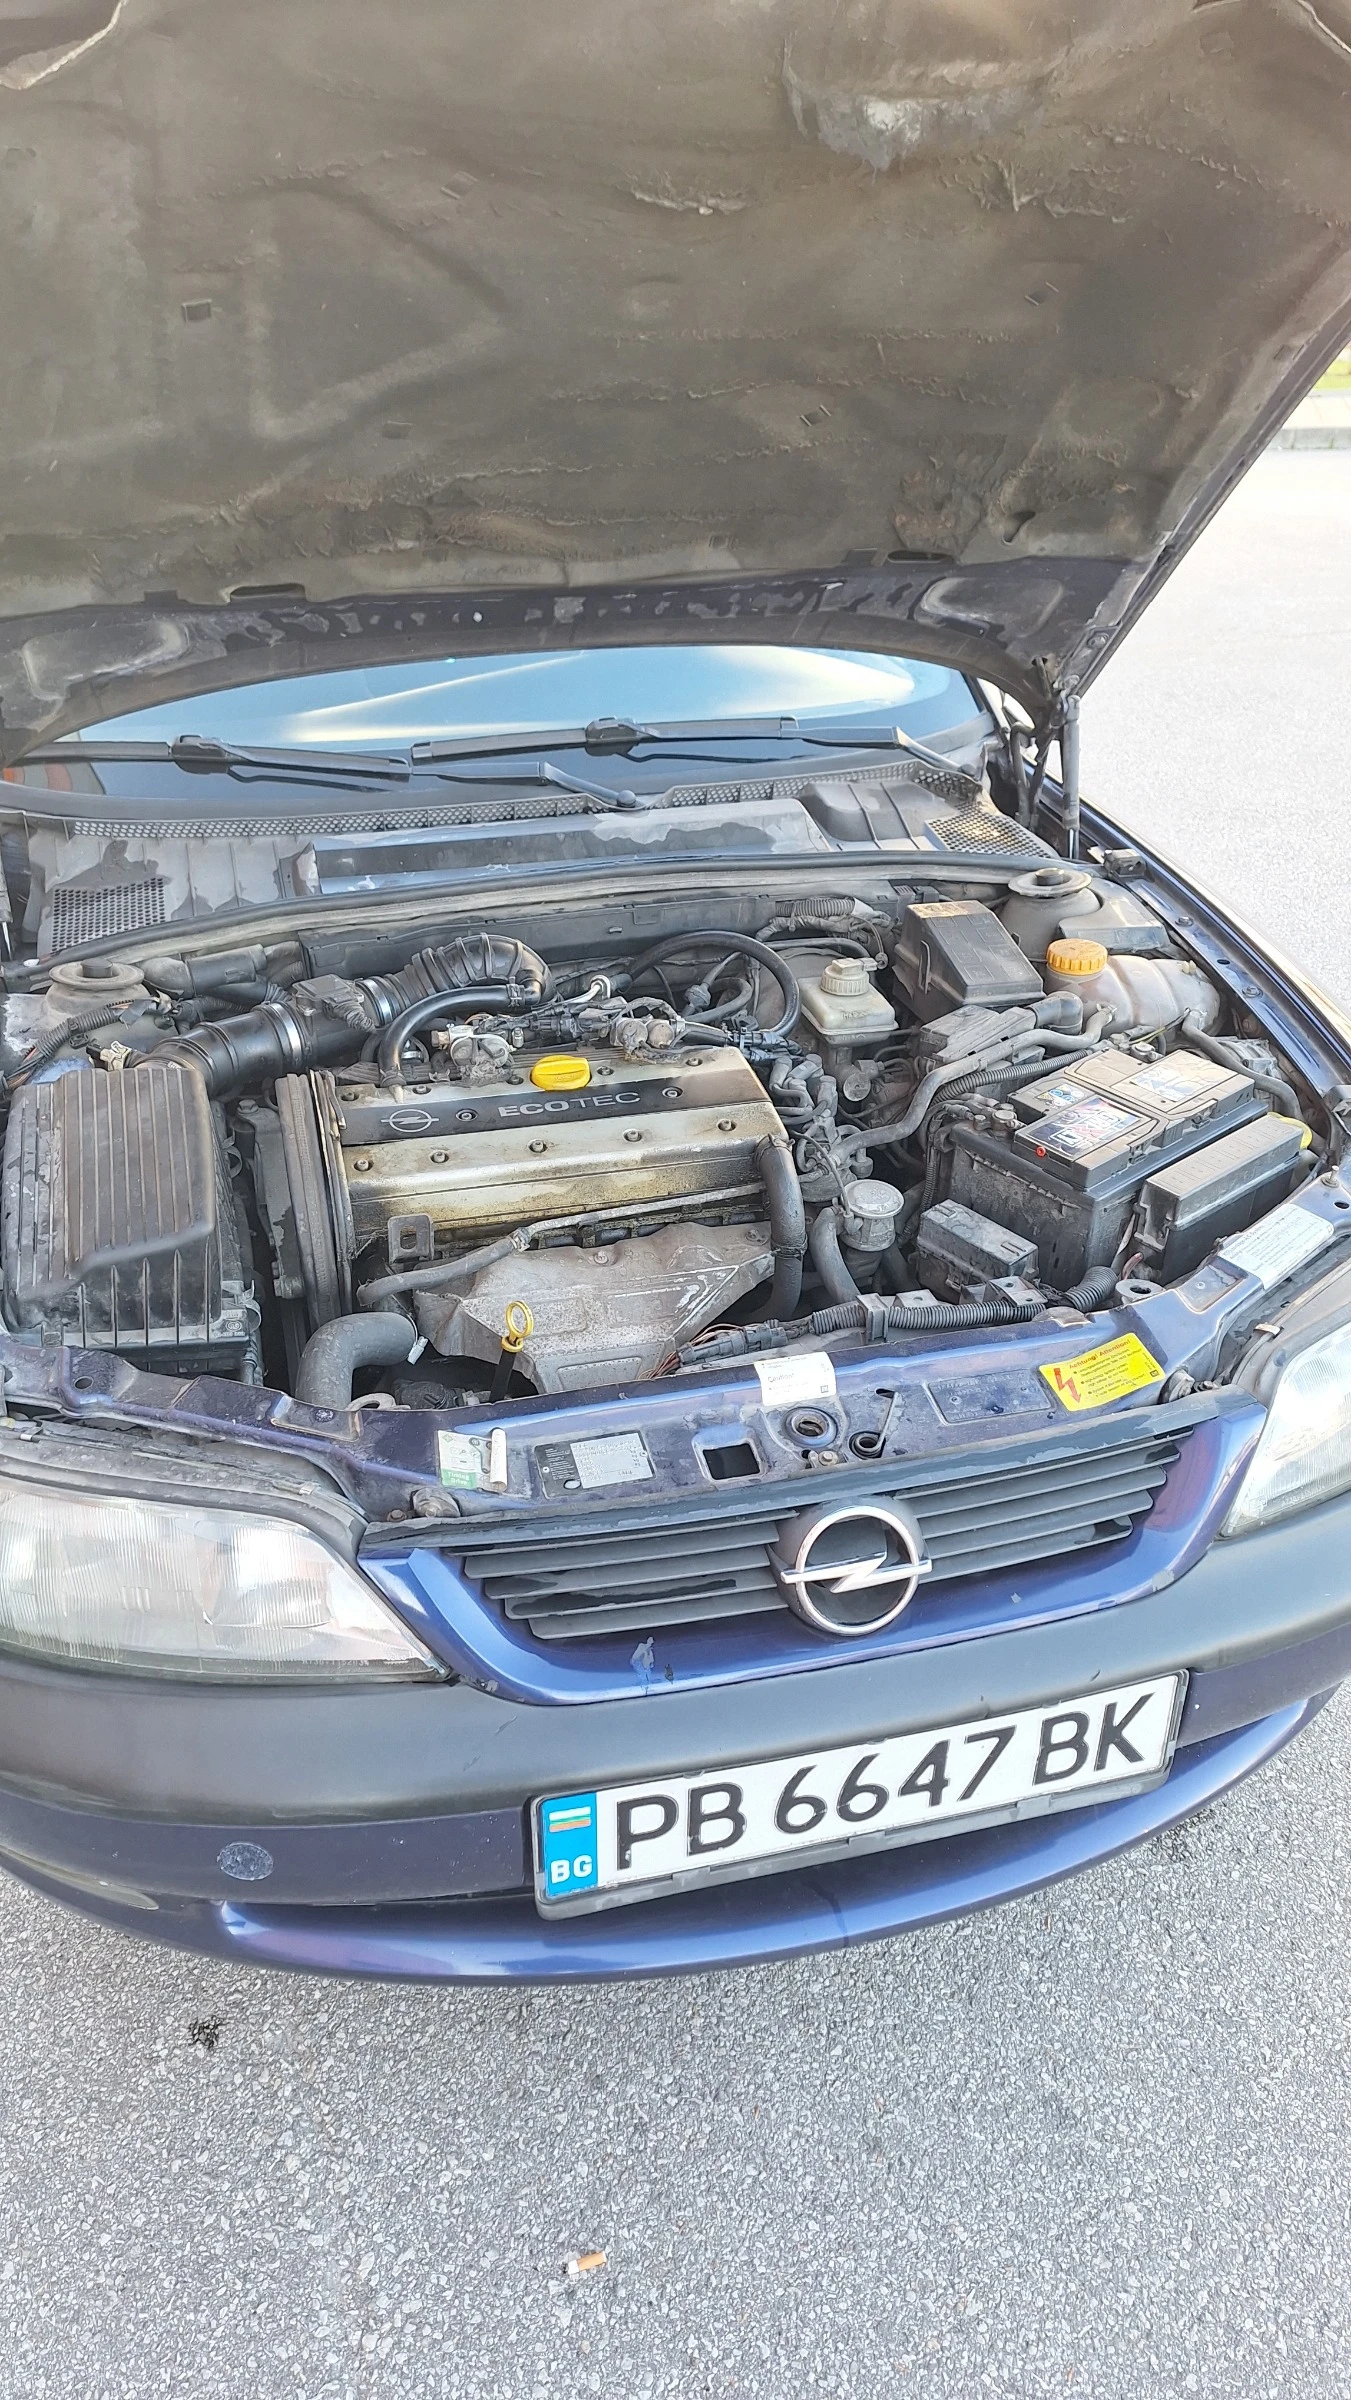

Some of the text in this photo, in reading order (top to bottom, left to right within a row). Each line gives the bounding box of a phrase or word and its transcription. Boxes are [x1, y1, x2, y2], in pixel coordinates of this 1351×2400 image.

[498, 1091, 641, 1118] ECOTEC
[615, 1693, 1157, 1870] PB 6647 BK
[550, 1855, 593, 1883] BG
